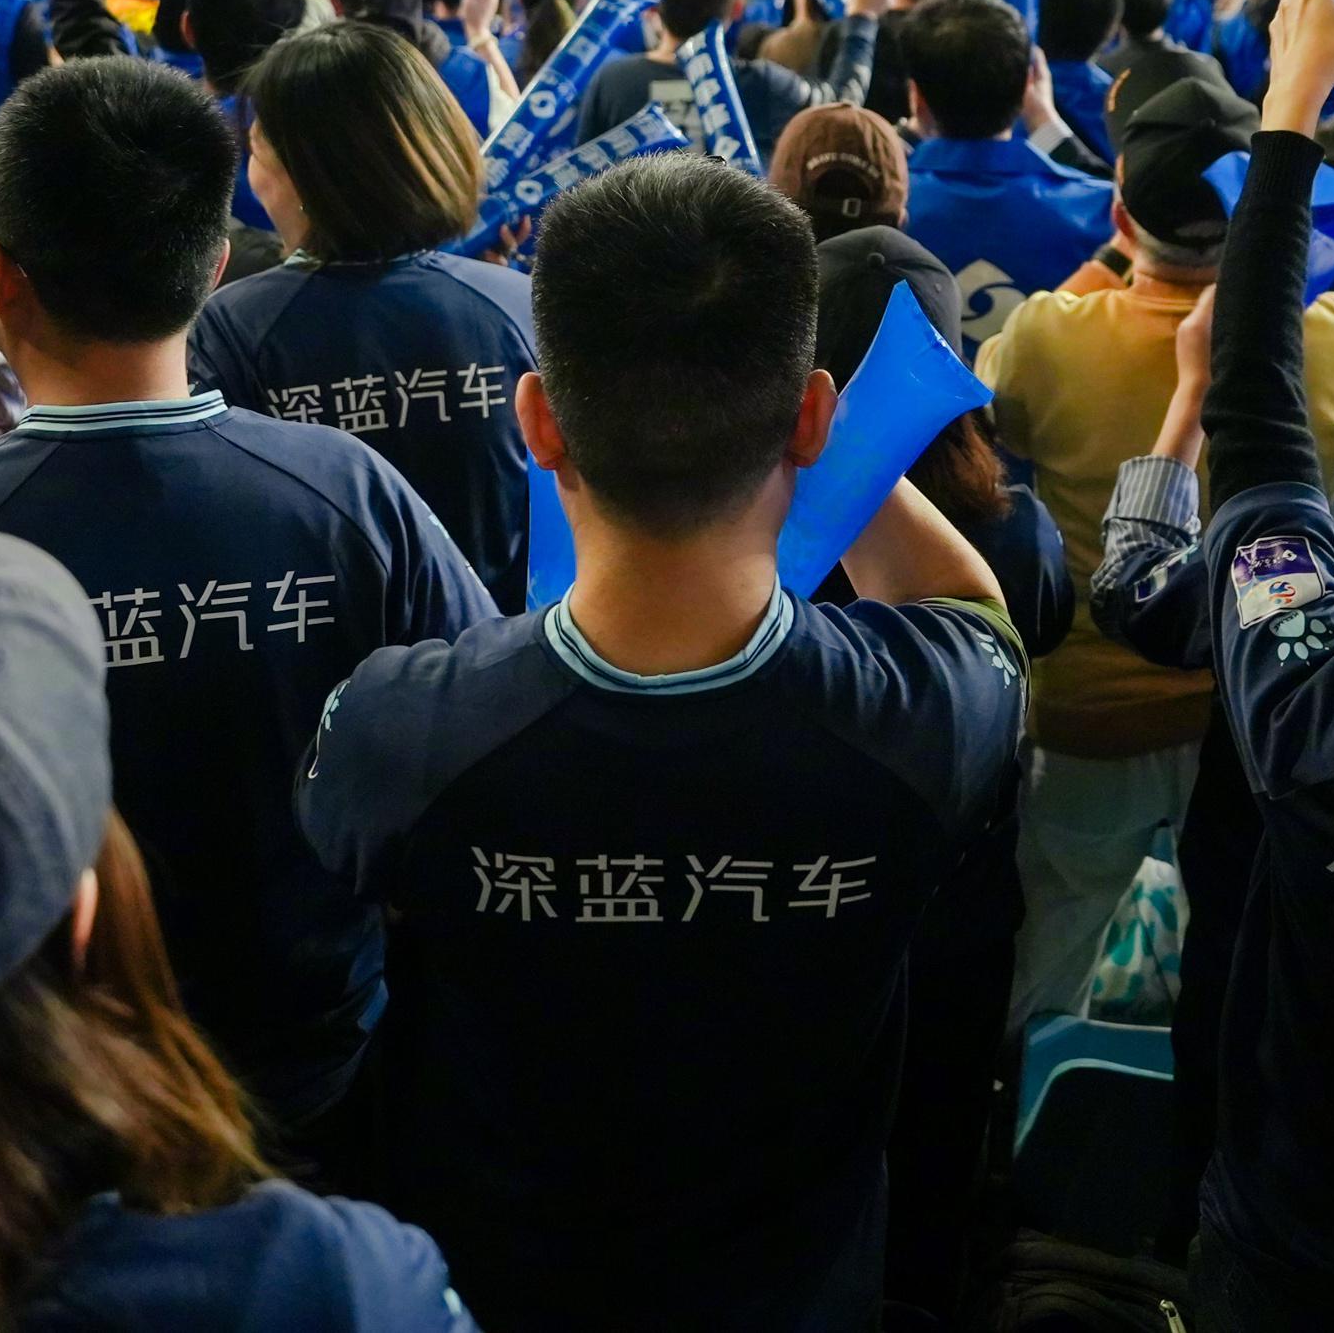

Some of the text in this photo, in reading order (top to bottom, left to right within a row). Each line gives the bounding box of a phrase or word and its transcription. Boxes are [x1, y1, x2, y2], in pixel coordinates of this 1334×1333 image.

[267, 362, 507, 434] 深蓝汽车
[470, 845, 878, 923] 深蓝汽车
